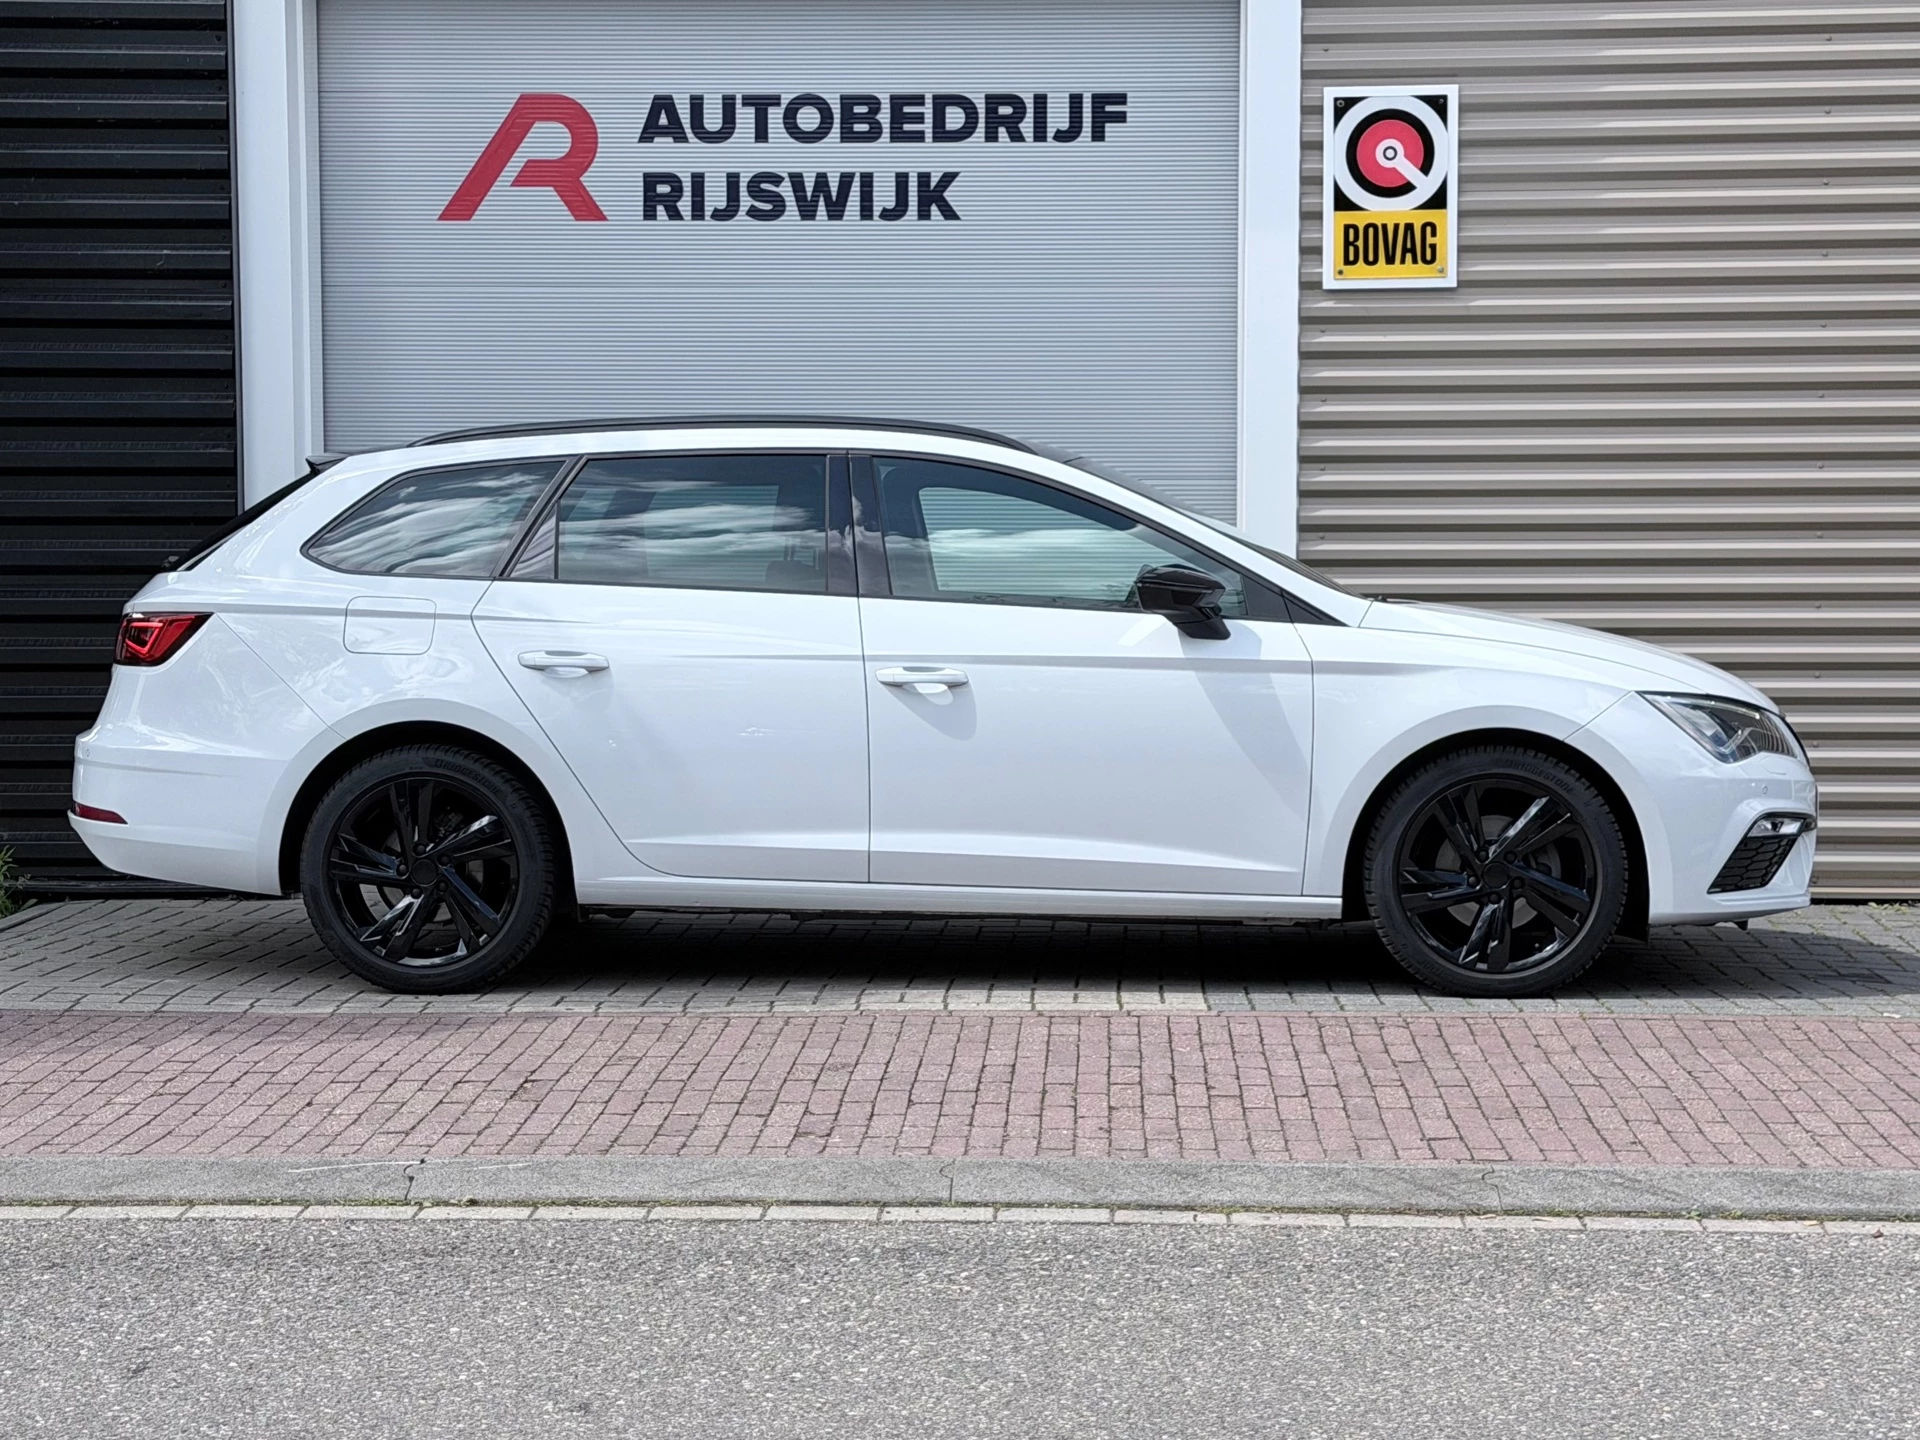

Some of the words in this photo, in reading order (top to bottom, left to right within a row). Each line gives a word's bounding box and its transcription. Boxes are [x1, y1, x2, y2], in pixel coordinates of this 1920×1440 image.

[637, 92, 1128, 144] AUTOBEDRIJF
[642, 171, 962, 222] RIJSWIJK
[1343, 221, 1437, 267] BOVAG
